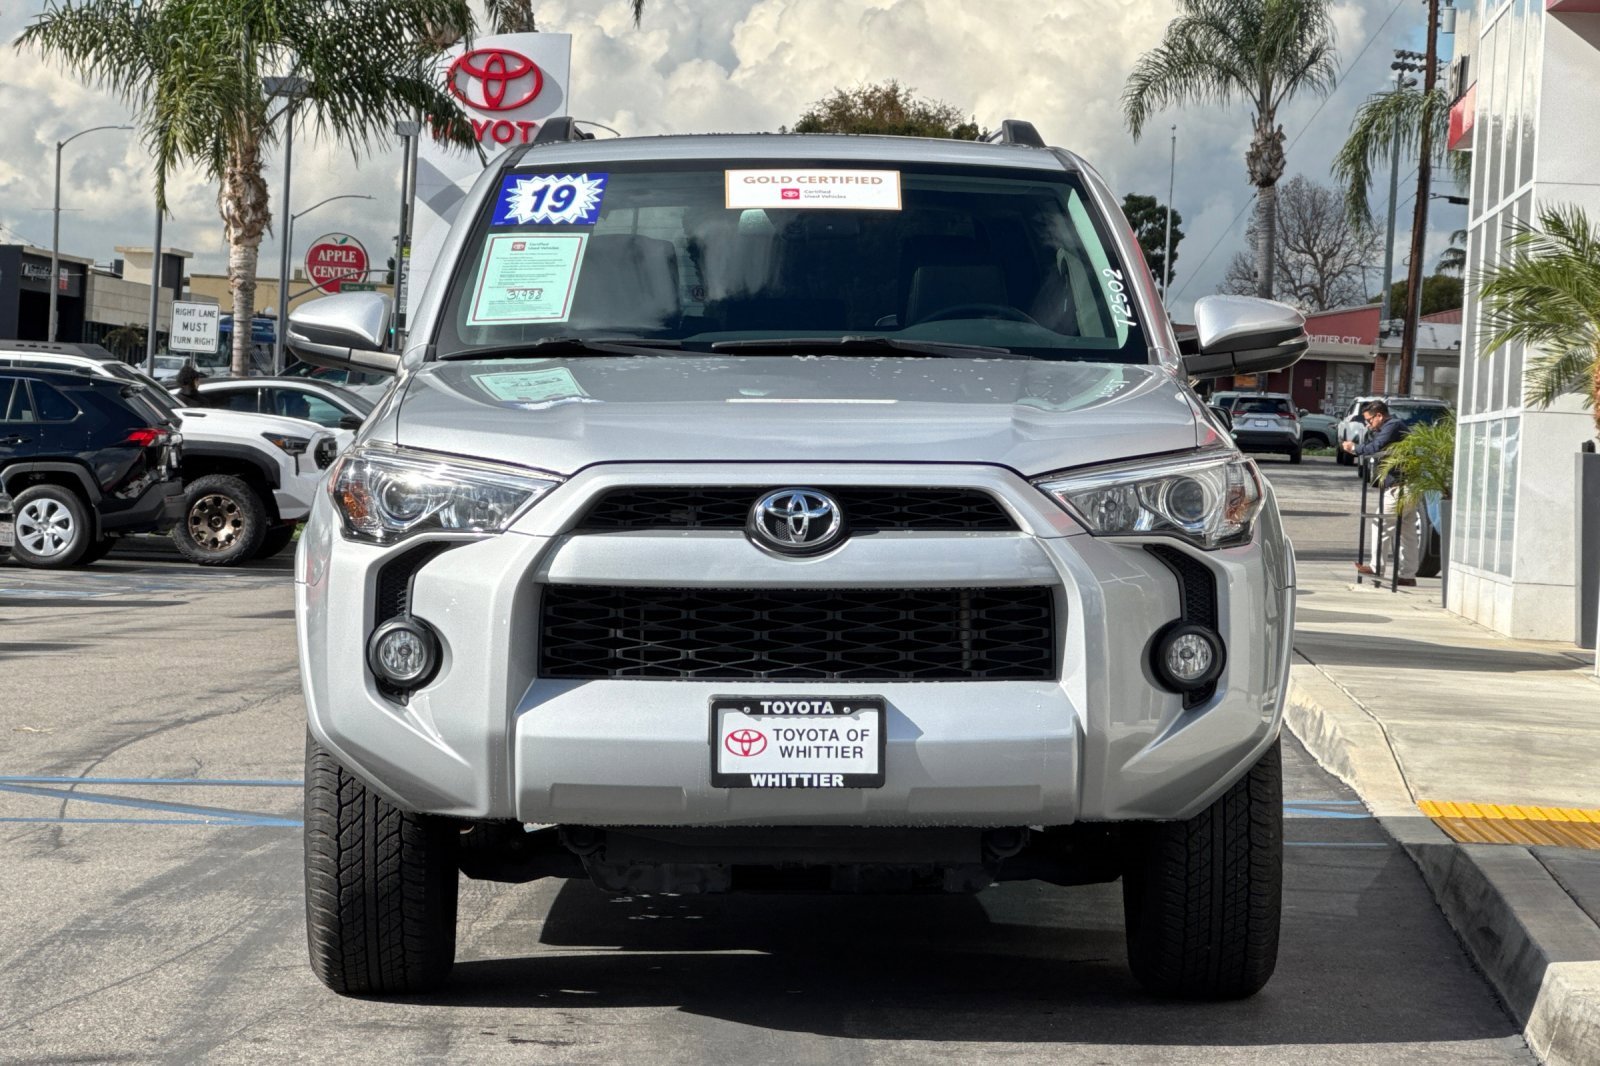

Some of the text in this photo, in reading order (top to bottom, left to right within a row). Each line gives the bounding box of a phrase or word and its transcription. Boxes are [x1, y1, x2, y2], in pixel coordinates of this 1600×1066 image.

[743, 176, 883, 185] GOLD CERTIFIED
[530, 184, 577, 213] 19
[318, 250, 357, 263] APPLE
[313, 265, 359, 280] CENTER
[1102, 268, 1137, 327] T2502
[175, 308, 216, 318] RIGHT LANE
[182, 322, 208, 332] MUST
[173, 336, 216, 346] TURN RIGHT
[1309, 335, 1361, 345] HITTIER CITY
[760, 701, 835, 714] TOYOTA
[773, 728, 870, 742] TOYOTA OF
[779, 746, 864, 759] WHITTIER
[750, 774, 844, 787] WHITTIER
